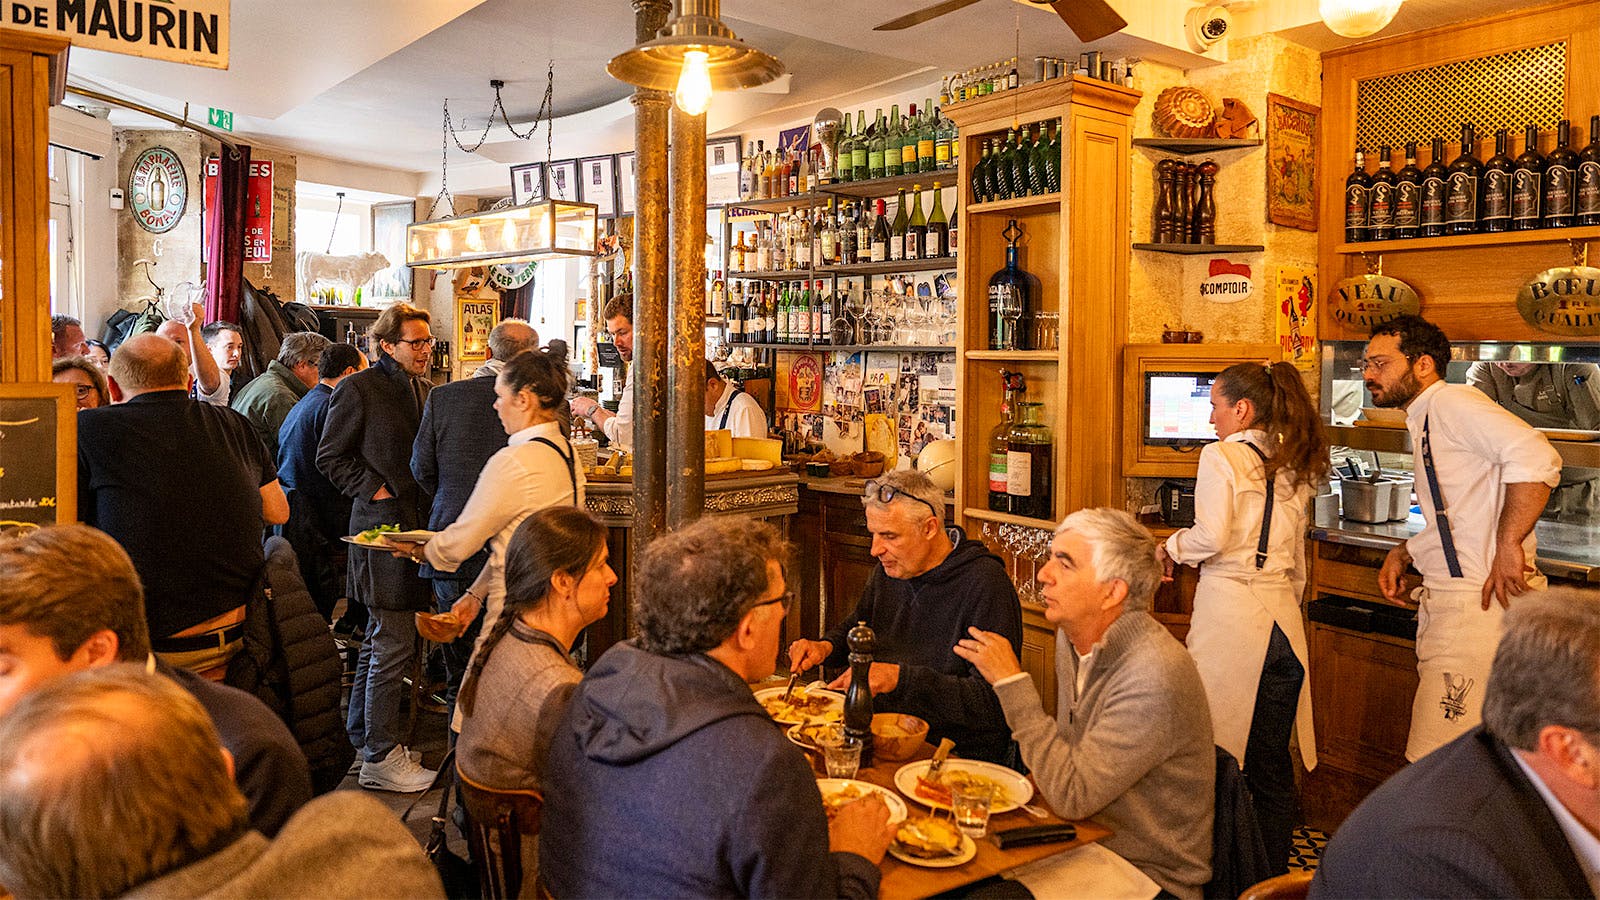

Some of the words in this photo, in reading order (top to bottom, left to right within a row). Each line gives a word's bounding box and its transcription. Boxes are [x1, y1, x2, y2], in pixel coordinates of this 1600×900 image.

[12, 3, 48, 28] DE
[56, 0, 219, 54] MAURIN
[140, 209, 177, 227] BONAL
[496, 272, 512, 287] CEP
[1205, 281, 1248, 295] COMPTOIR
[1338, 283, 1404, 302] VEAU
[464, 304, 493, 315] ATLAS
